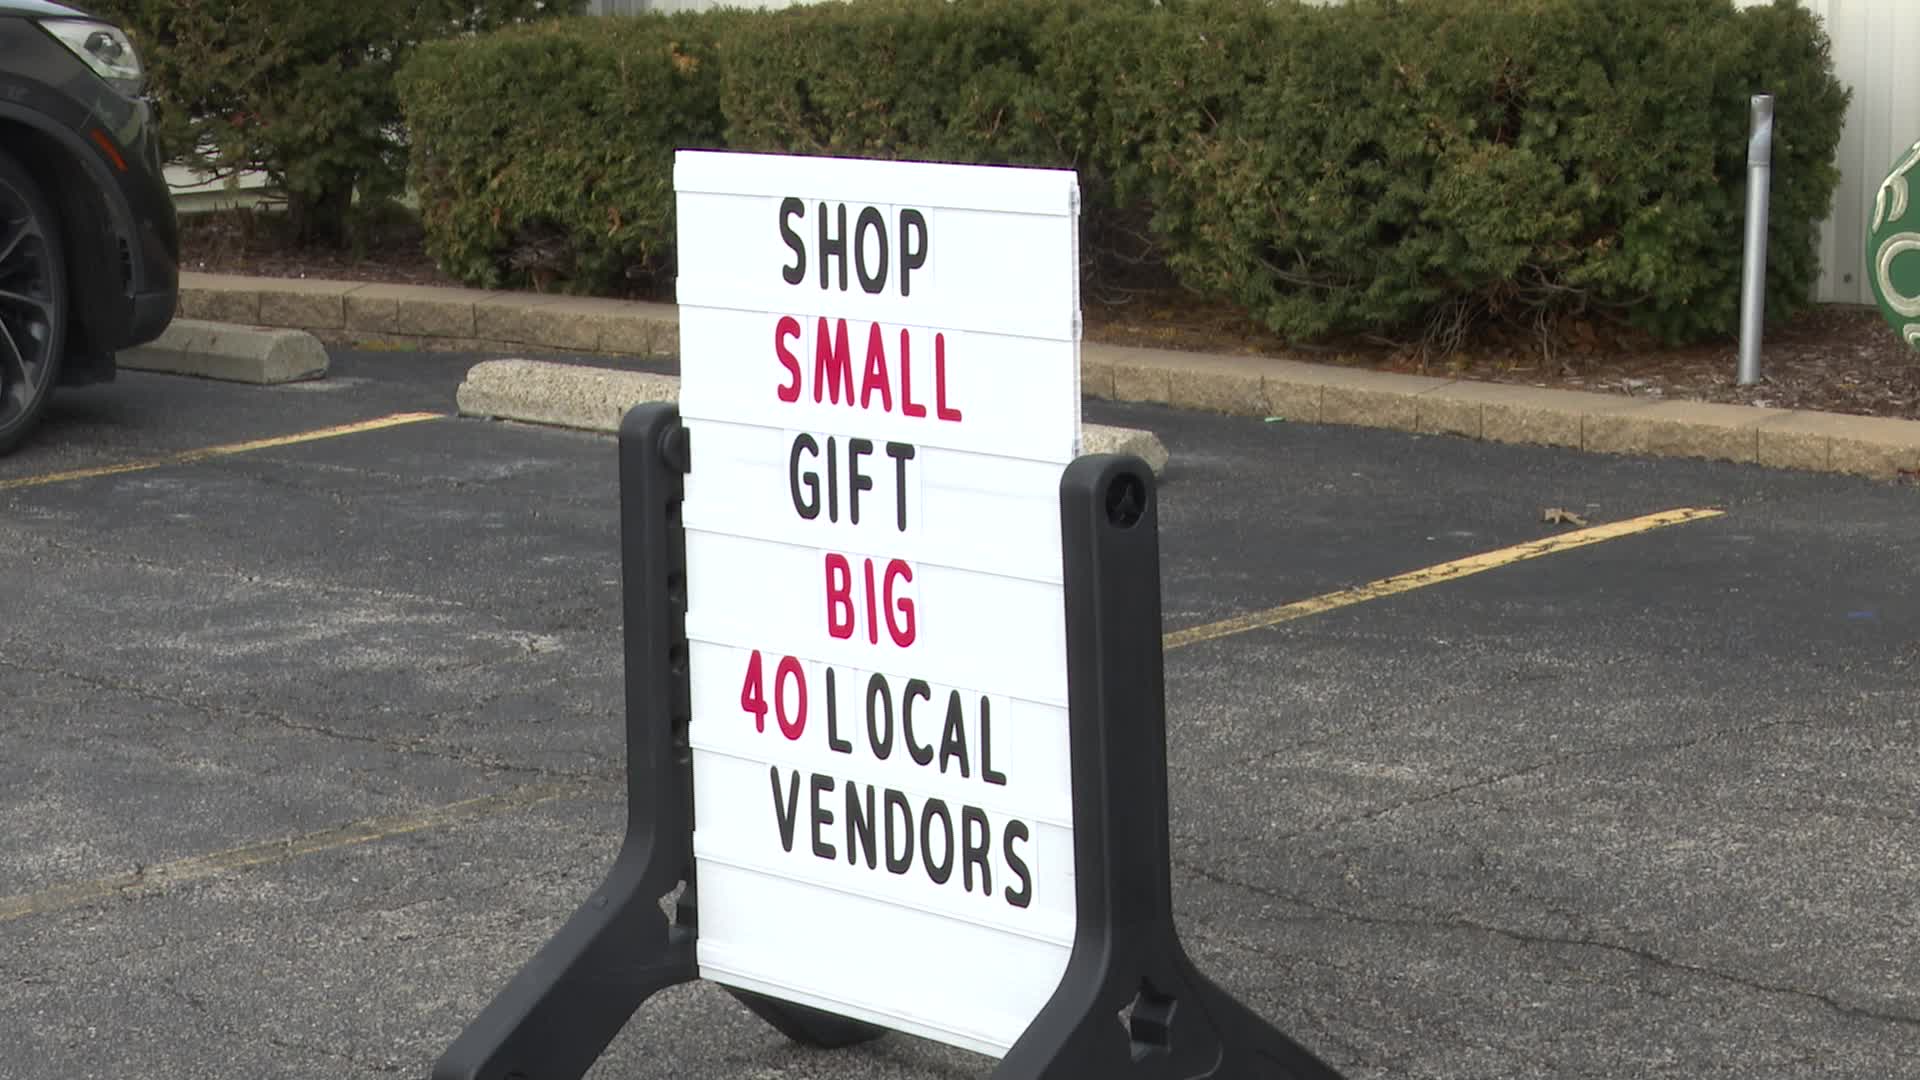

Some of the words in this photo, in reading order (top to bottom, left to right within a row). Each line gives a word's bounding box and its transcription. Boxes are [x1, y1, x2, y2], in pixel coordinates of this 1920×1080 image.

[779, 196, 928, 297] SHOP
[775, 315, 963, 422] SMALL
[789, 432, 916, 532] GIFT
[825, 553, 916, 649] BIG
[740, 649, 808, 741] 40
[826, 666, 1007, 786] LOCAL
[770, 765, 1032, 909] VENDORS
